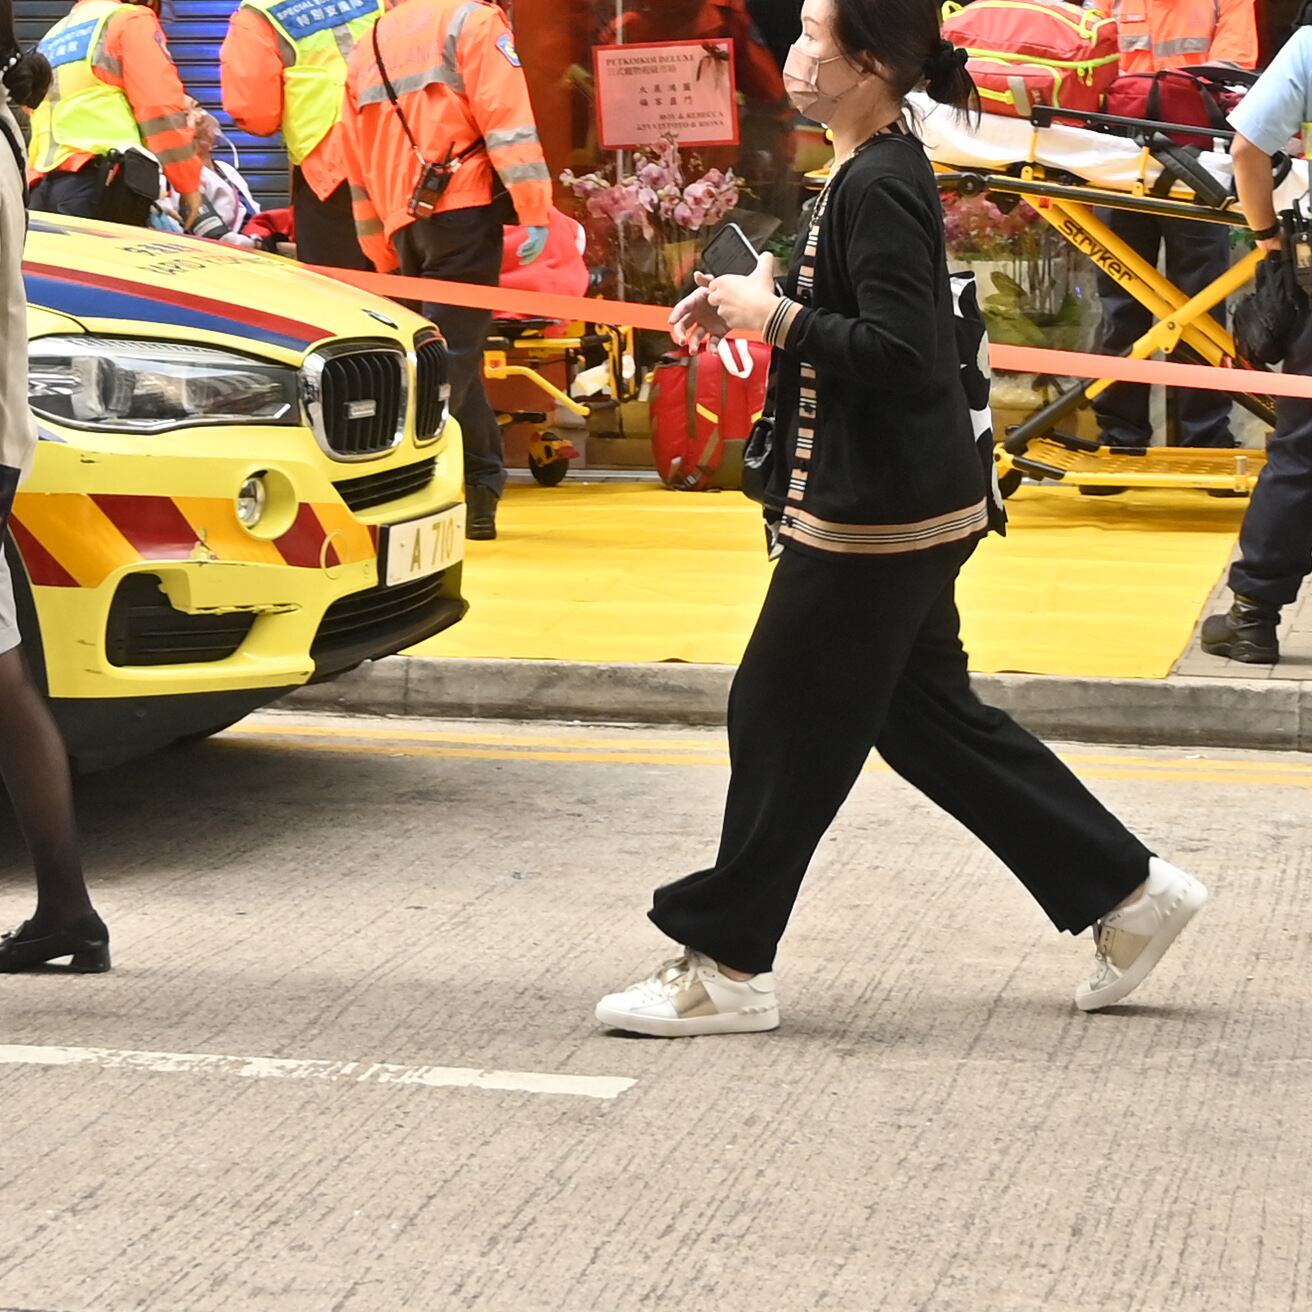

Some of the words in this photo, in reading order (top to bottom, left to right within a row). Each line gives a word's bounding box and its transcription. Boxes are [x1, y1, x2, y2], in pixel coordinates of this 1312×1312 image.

[1058, 219, 1135, 282] stryker
[410, 527, 421, 572] A
[432, 518, 454, 567] 710
